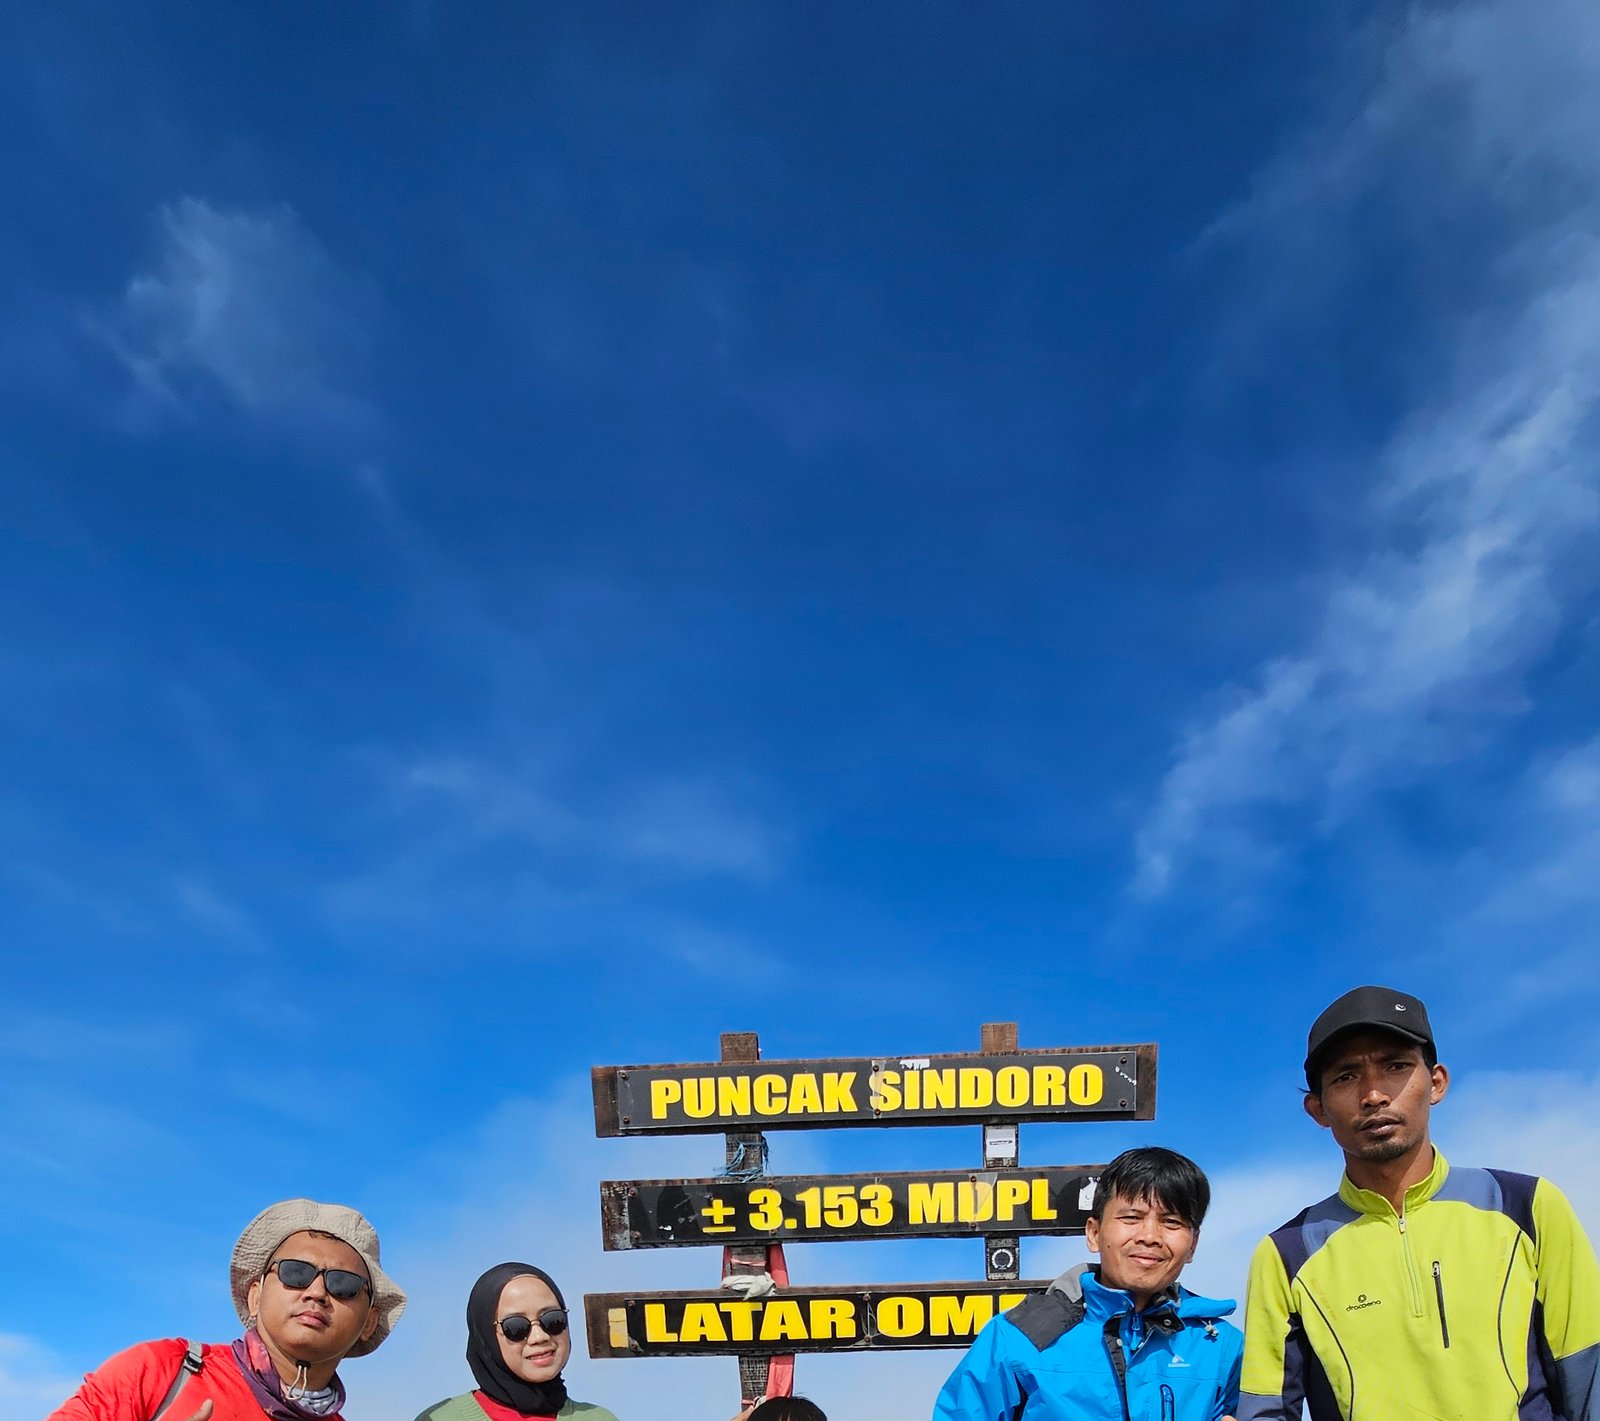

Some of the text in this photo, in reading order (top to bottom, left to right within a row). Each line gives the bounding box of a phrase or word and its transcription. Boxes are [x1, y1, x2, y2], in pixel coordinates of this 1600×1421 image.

[651, 1072, 859, 1120] PUNCAK
[869, 1064, 1104, 1113] SINDORO
[748, 1183, 894, 1232] 3.153
[908, 1178, 1058, 1225] MDPL
[644, 1299, 857, 1343] LATAR
